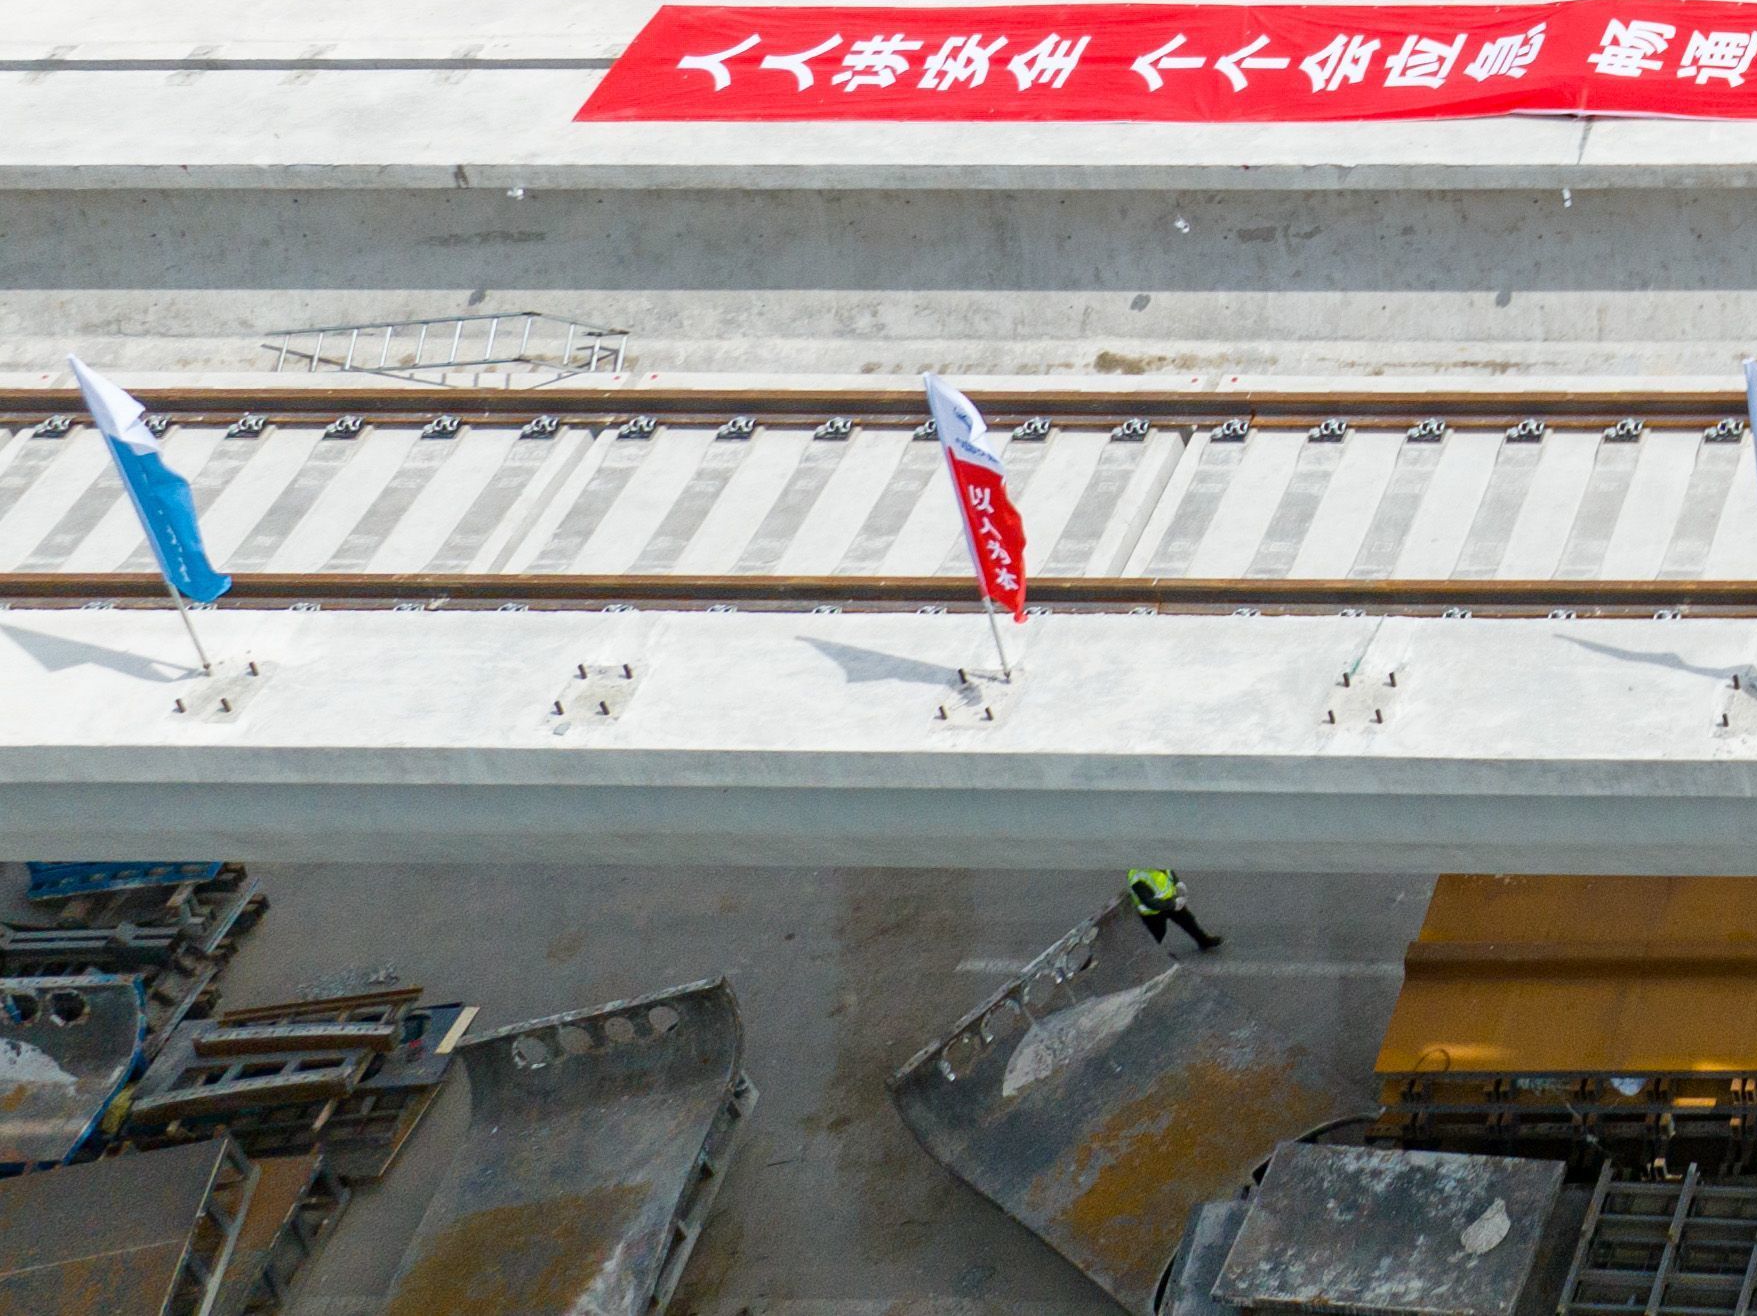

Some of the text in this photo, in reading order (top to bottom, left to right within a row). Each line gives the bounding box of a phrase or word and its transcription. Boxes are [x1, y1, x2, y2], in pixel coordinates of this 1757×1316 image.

[675, 32, 1092, 93] 人人讲安全
[1129, 21, 1547, 94] 个个会应急
[968, 484, 1019, 592] 以人为本
